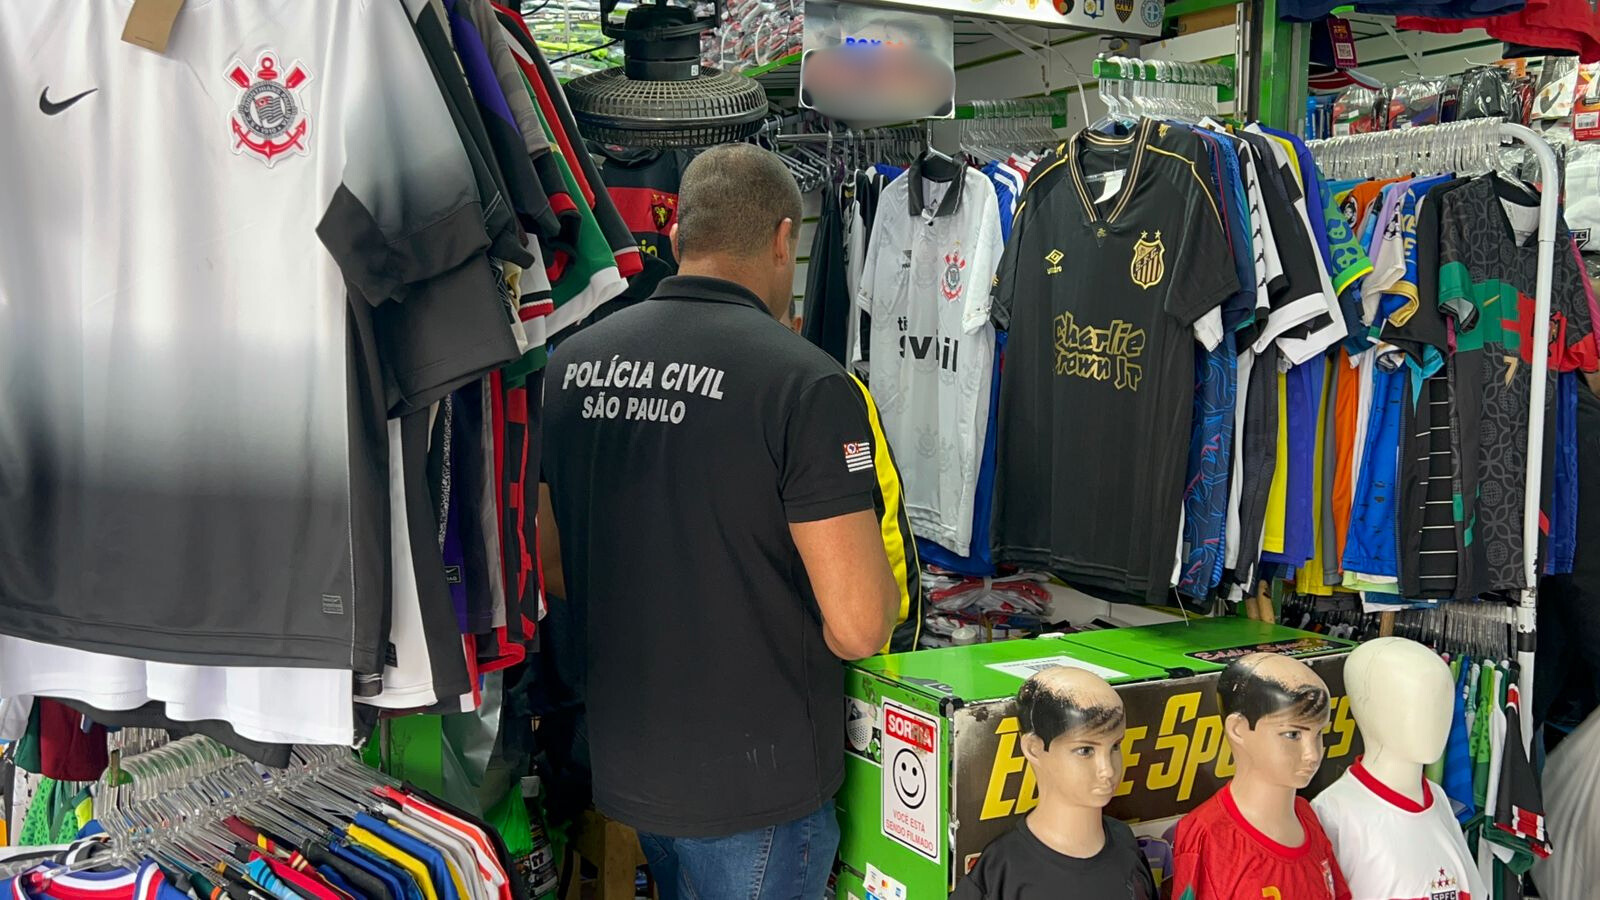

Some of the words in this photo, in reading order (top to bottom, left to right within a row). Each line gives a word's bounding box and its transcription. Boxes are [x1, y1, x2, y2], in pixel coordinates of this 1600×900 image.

[1054, 311, 1146, 358] Charlie
[562, 354, 655, 390] POLÍCIA
[660, 362, 725, 400] CIVIL
[581, 391, 621, 419] SÃO
[625, 397, 687, 425] PAULO
[887, 714, 933, 748] SORRIA
[886, 819, 906, 837] SENDO
[906, 830, 934, 852] FILMADO
